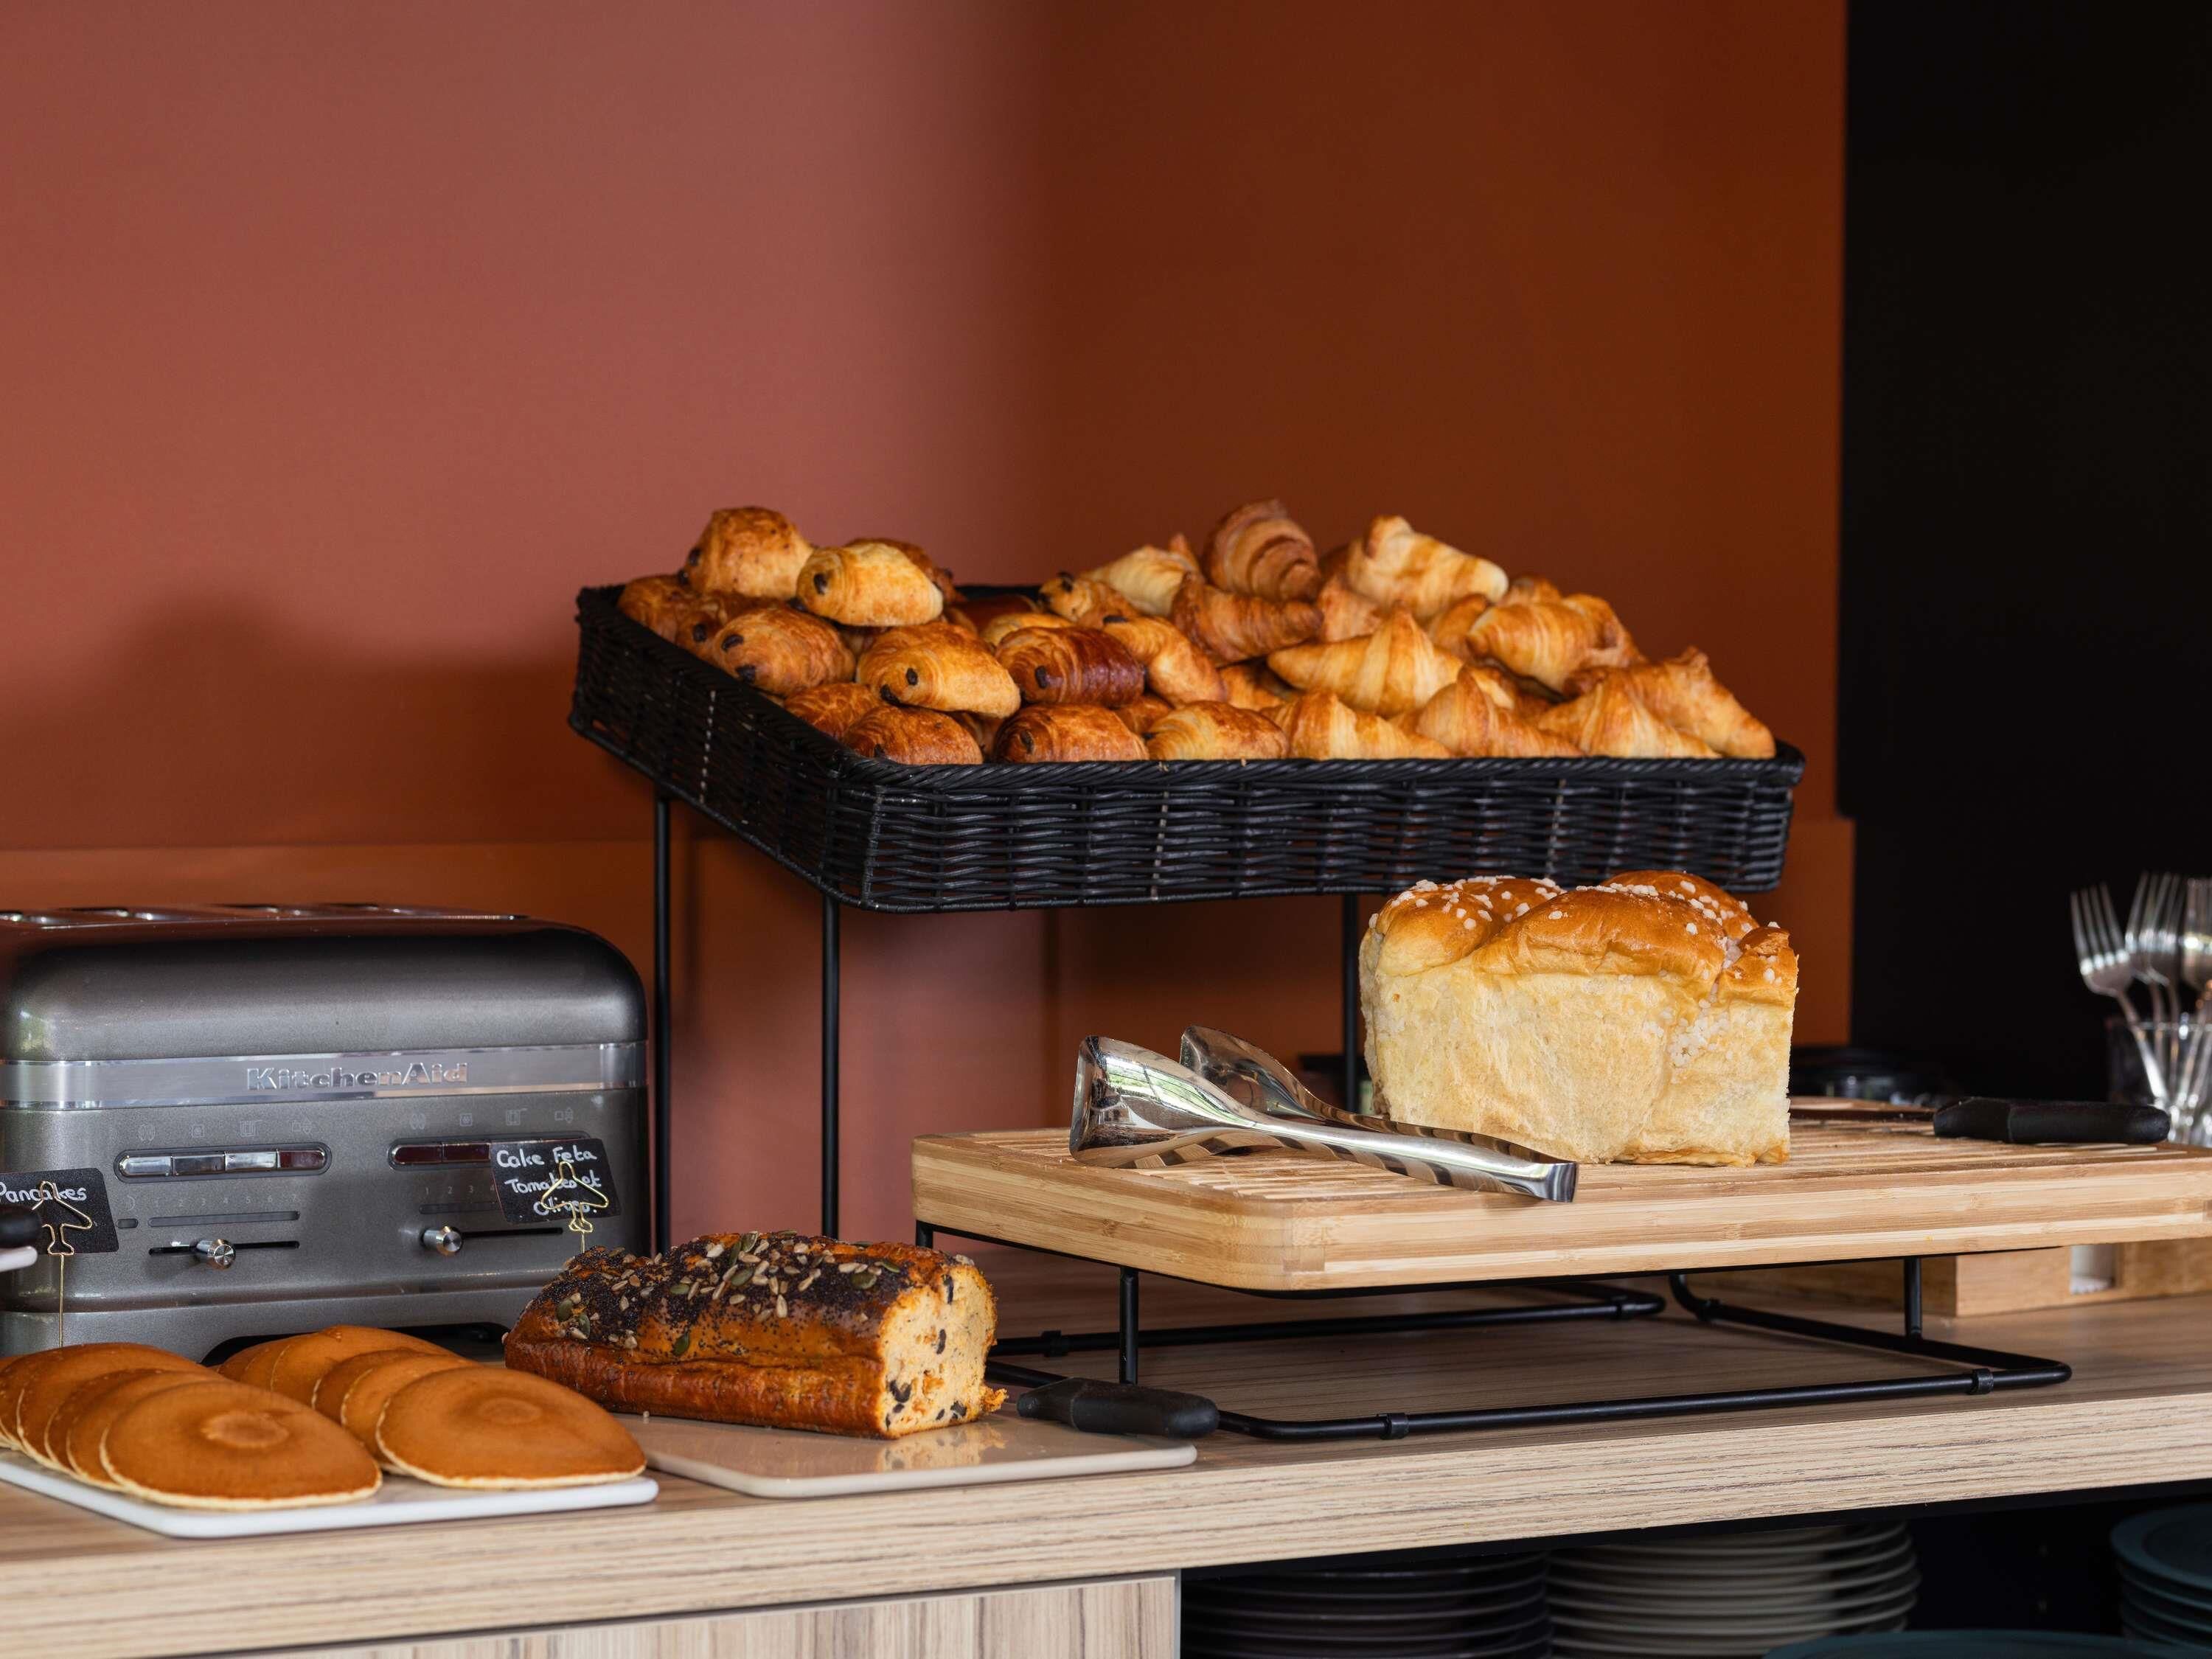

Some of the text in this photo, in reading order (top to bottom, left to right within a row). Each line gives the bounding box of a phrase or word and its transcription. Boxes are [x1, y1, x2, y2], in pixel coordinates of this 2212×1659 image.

[248, 1062, 467, 1091] KitchenAid
[496, 1144, 598, 1168] Cake Feta
[448, 1186, 453, 1194] 2
[468, 1184, 474, 1194] 3
[504, 1169, 602, 1194] Tomates et
[246, 1196, 251, 1204] 5
[268, 1194, 273, 1203] 6
